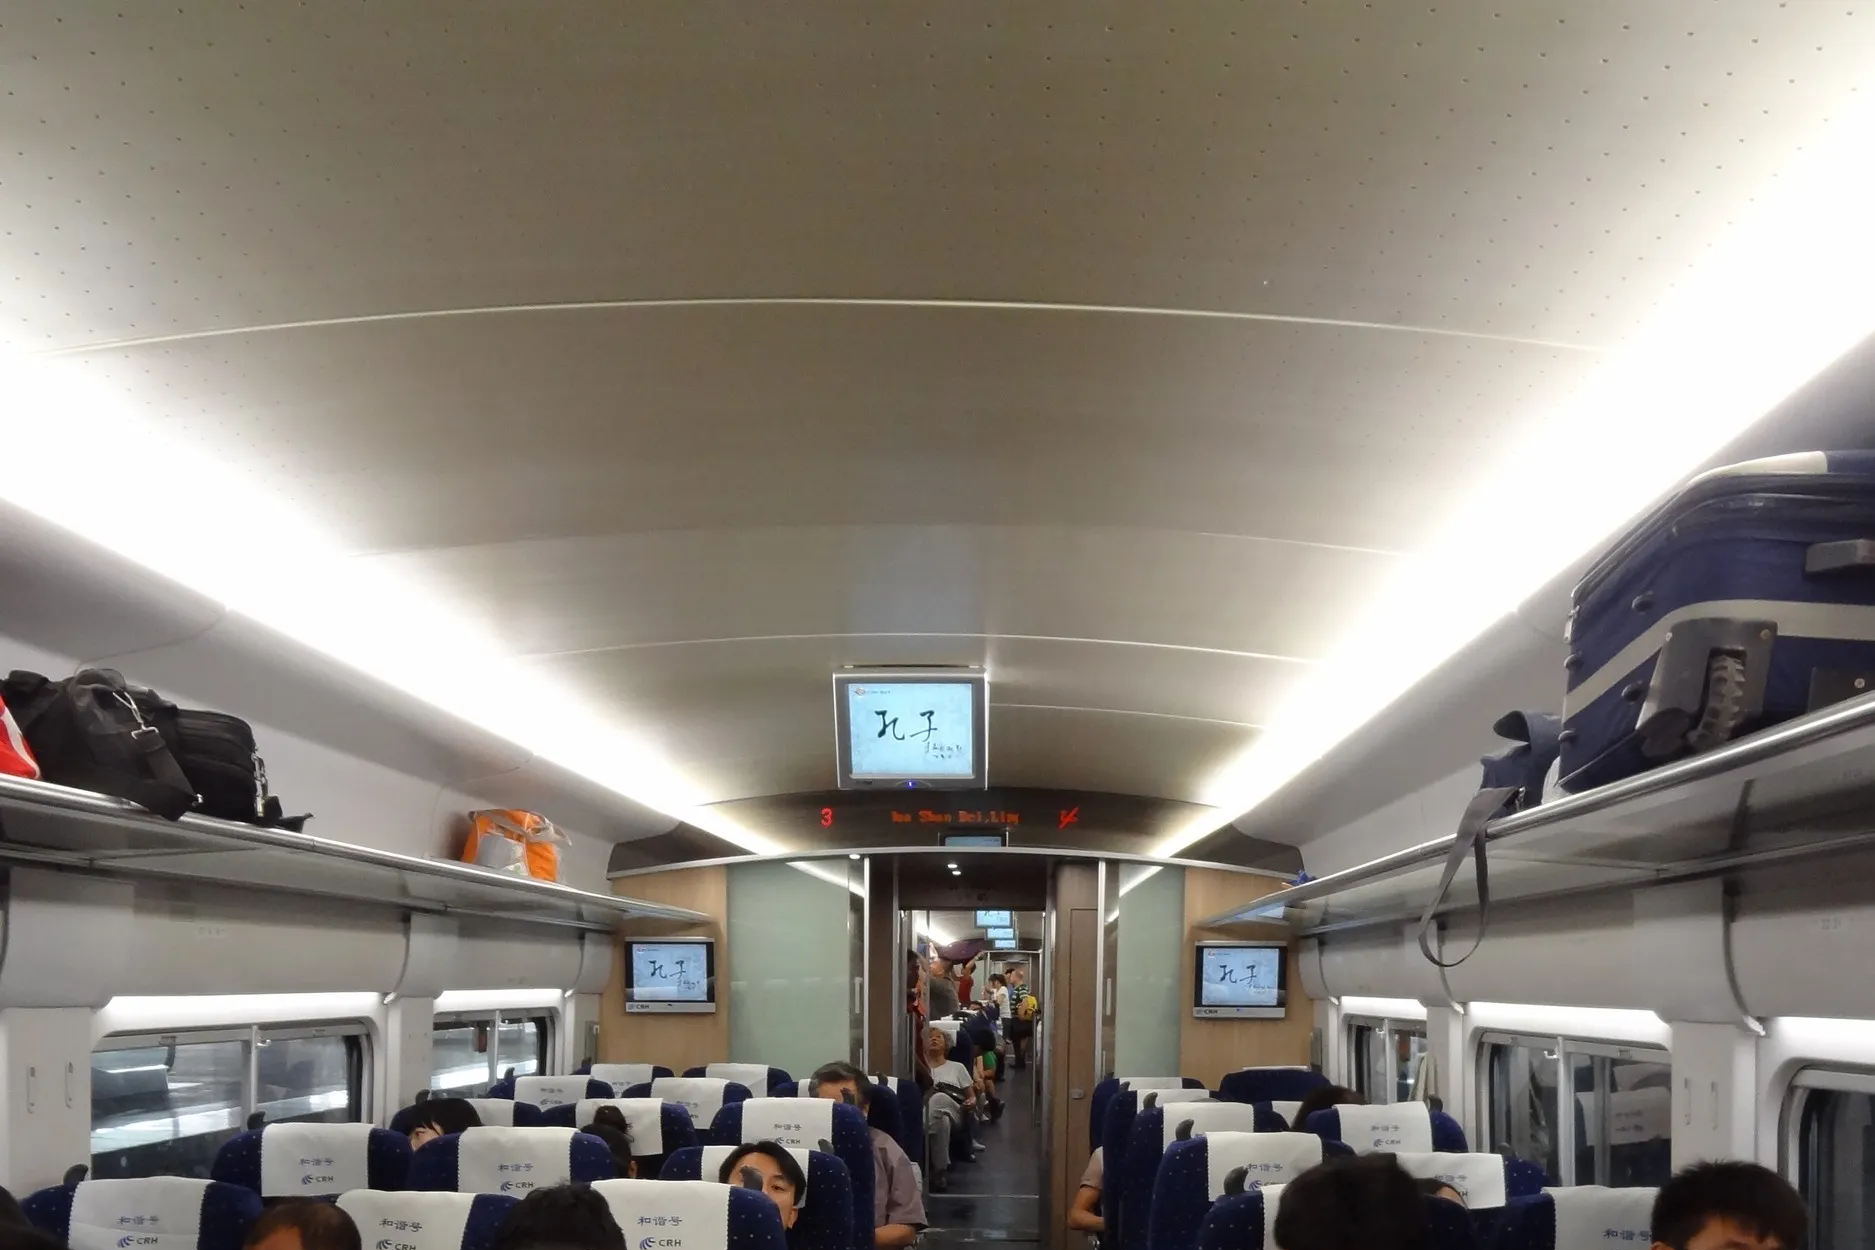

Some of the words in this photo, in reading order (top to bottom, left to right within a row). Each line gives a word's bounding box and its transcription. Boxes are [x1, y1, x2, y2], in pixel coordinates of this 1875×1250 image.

[874, 709, 938, 742] 孔子
[820, 807, 833, 828] 3
[648, 960, 687, 979] 孔子
[1219, 964, 1257, 984] 孔子
[515, 1181, 534, 1189] CRH
[379, 1218, 422, 1233] 和谐号
[637, 1216, 683, 1227] 和谐号
[136, 1236, 159, 1245] CRH
[658, 1239, 682, 1247] CRH
